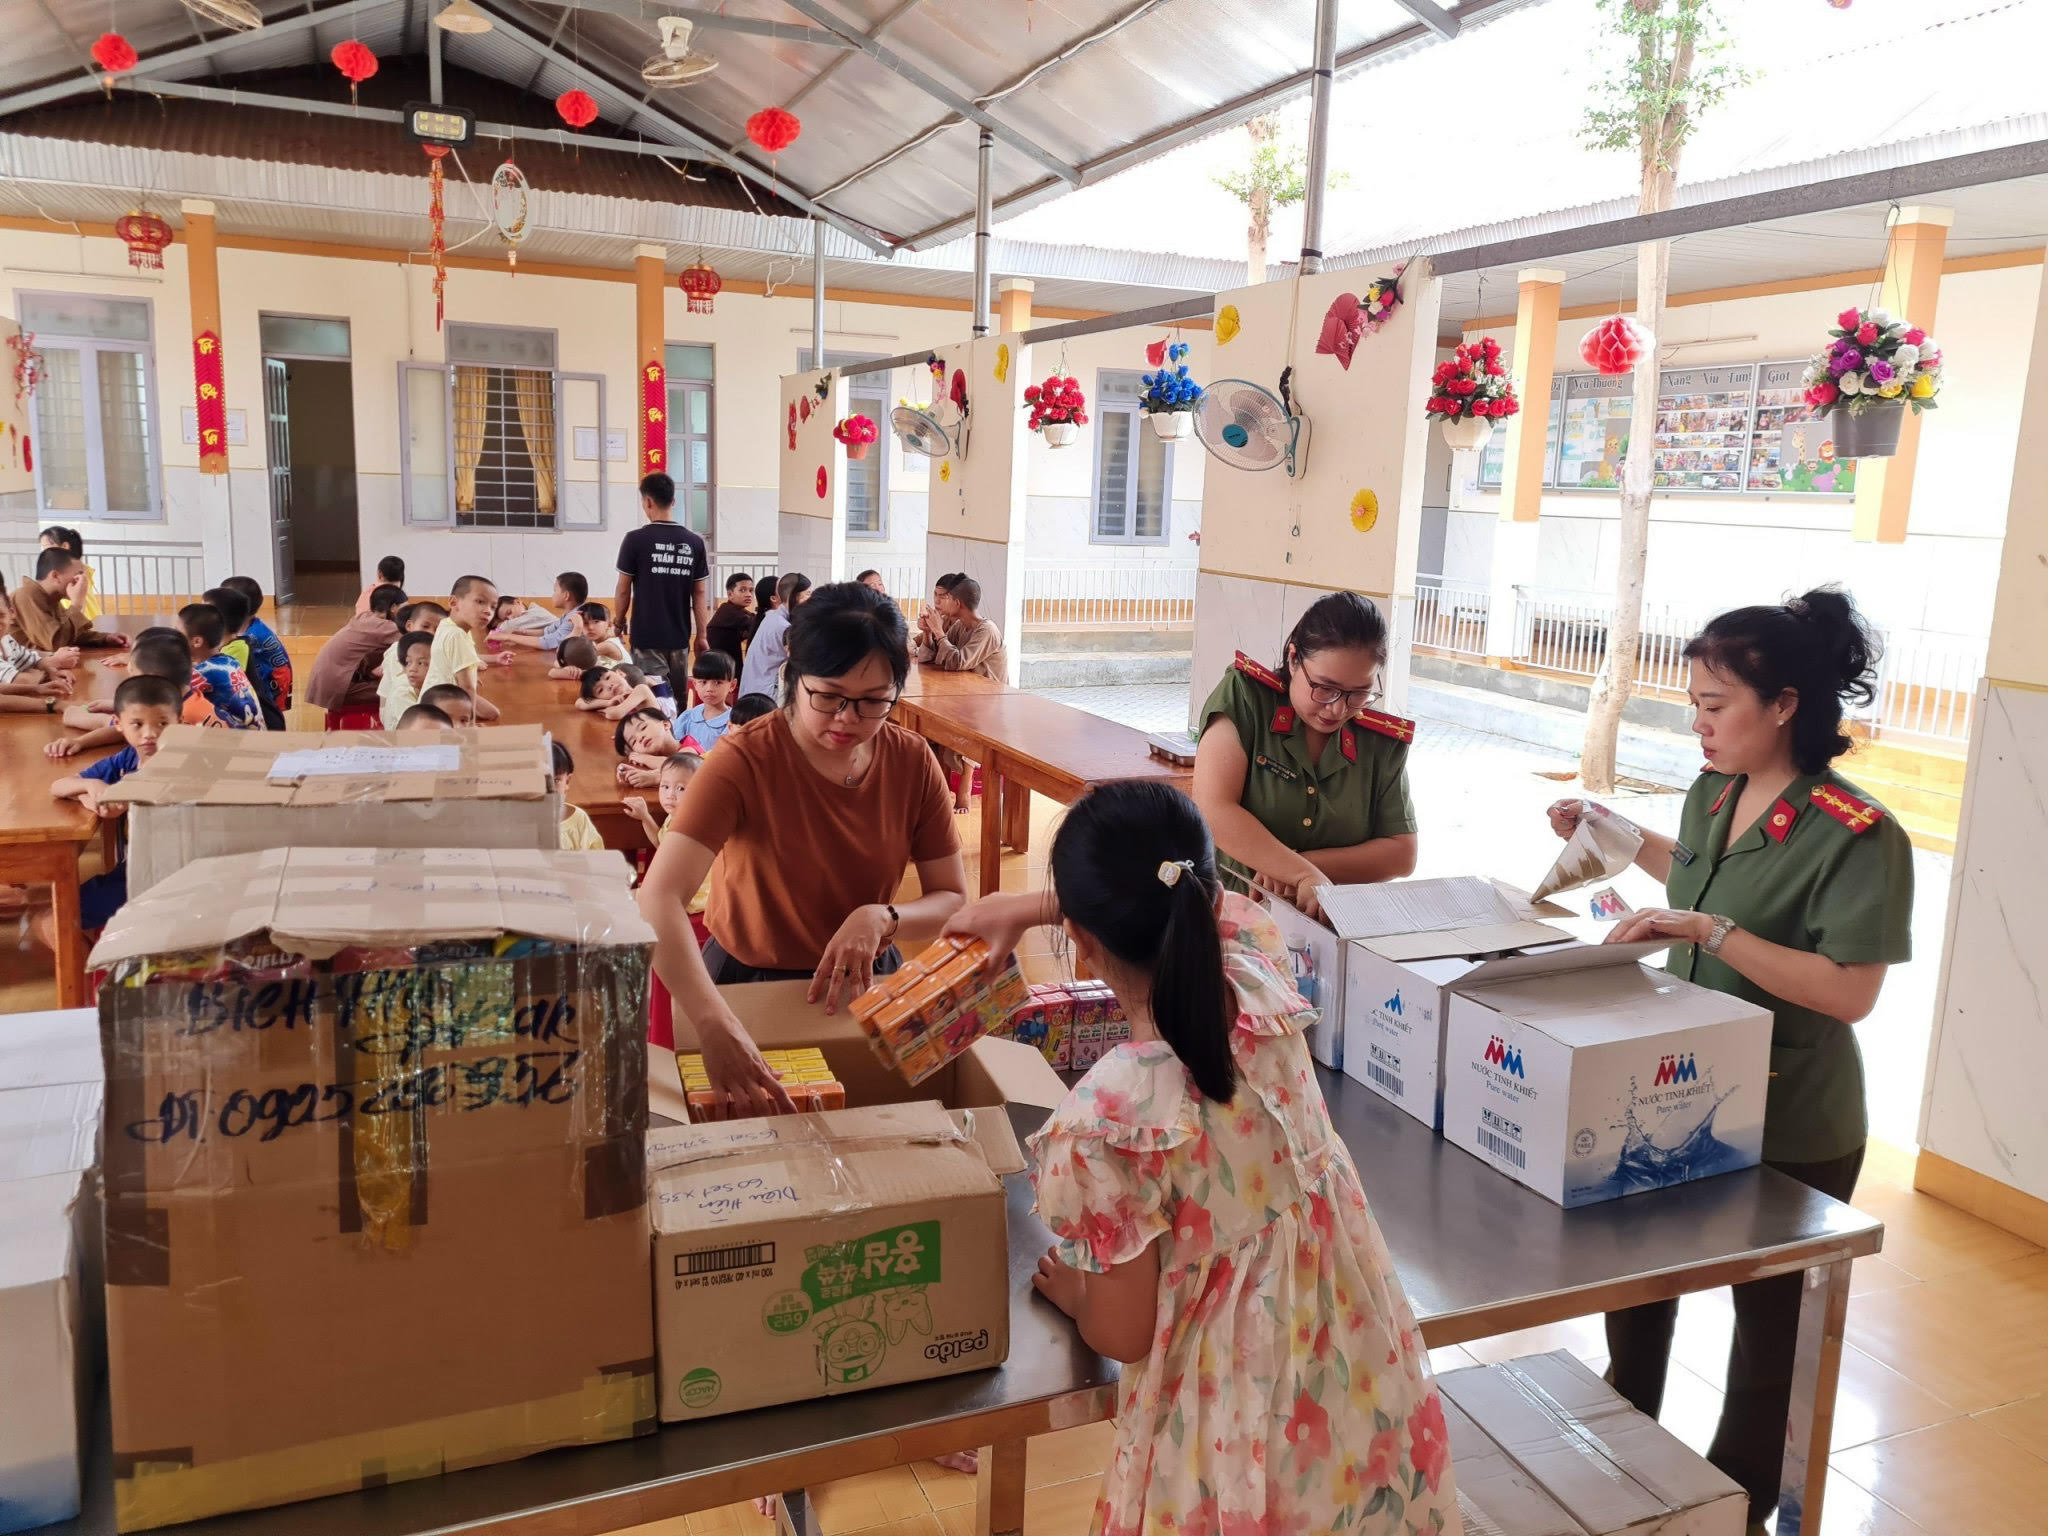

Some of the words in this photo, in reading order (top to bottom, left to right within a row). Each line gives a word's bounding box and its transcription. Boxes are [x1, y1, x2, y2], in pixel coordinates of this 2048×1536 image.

[676, 555, 693, 566] HUY
[1486, 1080, 1501, 1094] Pure
[1501, 1091, 1520, 1103] water
[1656, 1105, 1673, 1115] Pure
[1673, 1101, 1692, 1111] water
[863, 1230, 925, 1280] 홍삼
[924, 1329, 989, 1364] paldo
